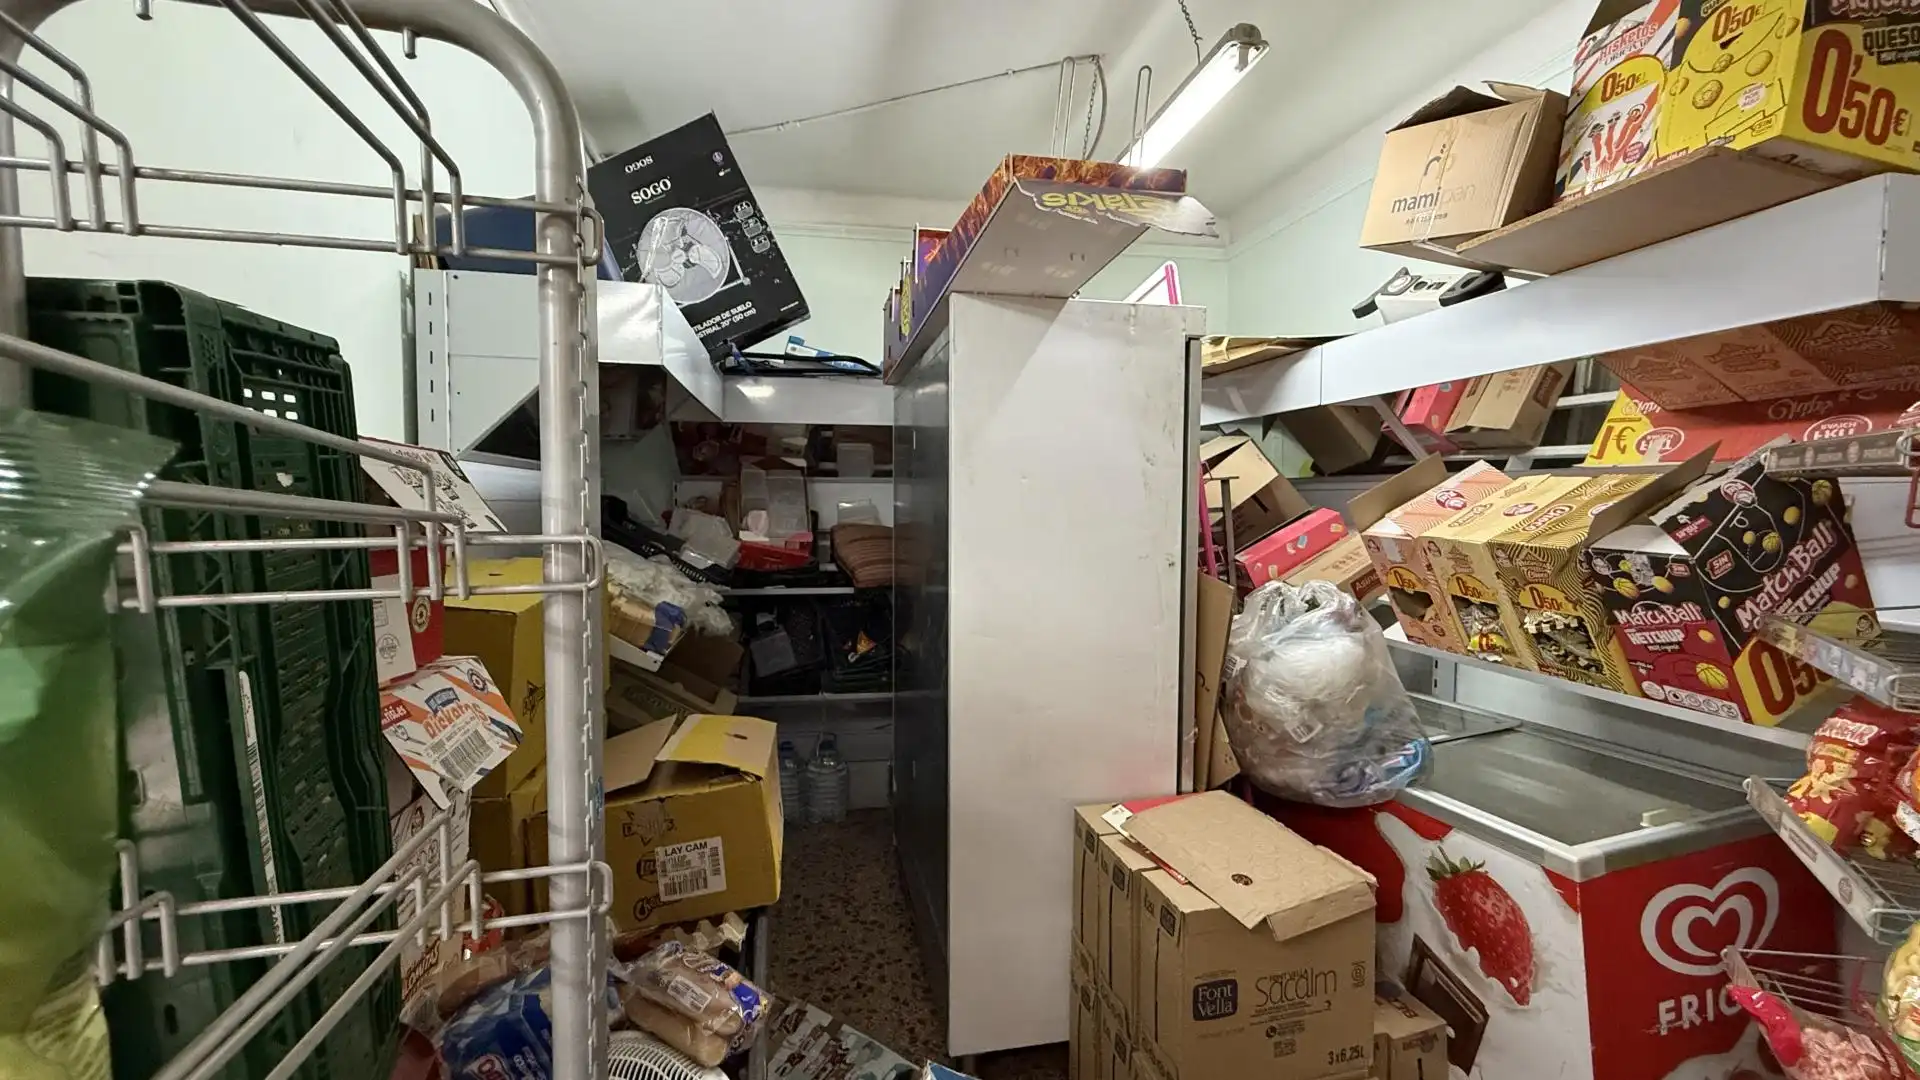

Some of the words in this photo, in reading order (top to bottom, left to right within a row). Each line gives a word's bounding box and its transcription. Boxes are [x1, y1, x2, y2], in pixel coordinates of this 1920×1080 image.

[631, 178, 671, 205] SOGO
[692, 315, 722, 332] TILADOR
[730, 301, 753, 315] SUELO
[697, 325, 722, 338] STRIAL
[1712, 554, 1728, 568] SIN
[1735, 521, 1834, 630] MatchBall
[1788, 562, 1841, 622] ETCHUP
[1612, 602, 1703, 627] MatchBall
[664, 846, 683, 857] LAY
[685, 841, 708, 853] CAM
[1198, 984, 1233, 1000] Font
[1255, 967, 1337, 1008] Sacalm
[1197, 1001, 1234, 1018] Vella
